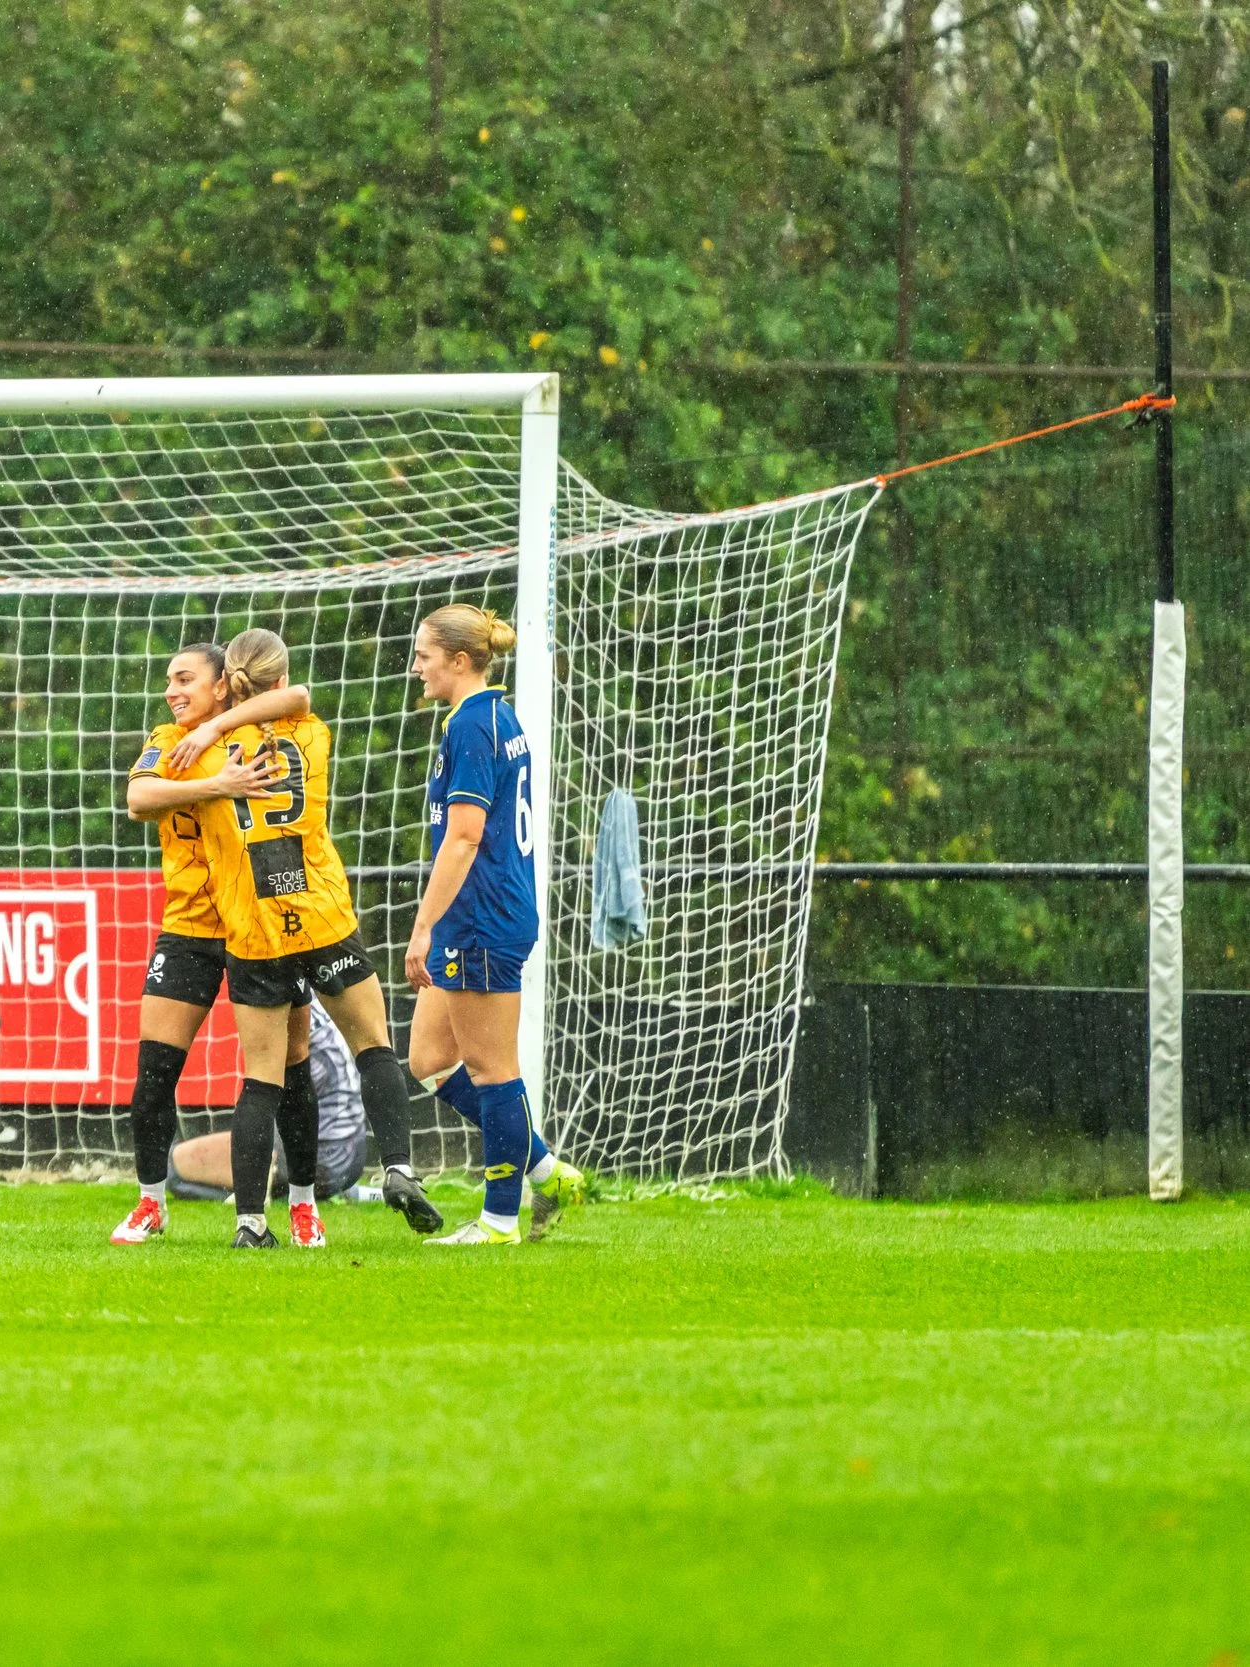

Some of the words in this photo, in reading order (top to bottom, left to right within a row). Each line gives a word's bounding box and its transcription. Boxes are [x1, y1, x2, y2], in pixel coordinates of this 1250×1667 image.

[548, 521, 556, 582] HARROD
[227, 737, 305, 832] 19
[515, 766, 534, 857] 6
[267, 869, 306, 886] STONE
[275, 880, 307, 895] RIDGE
